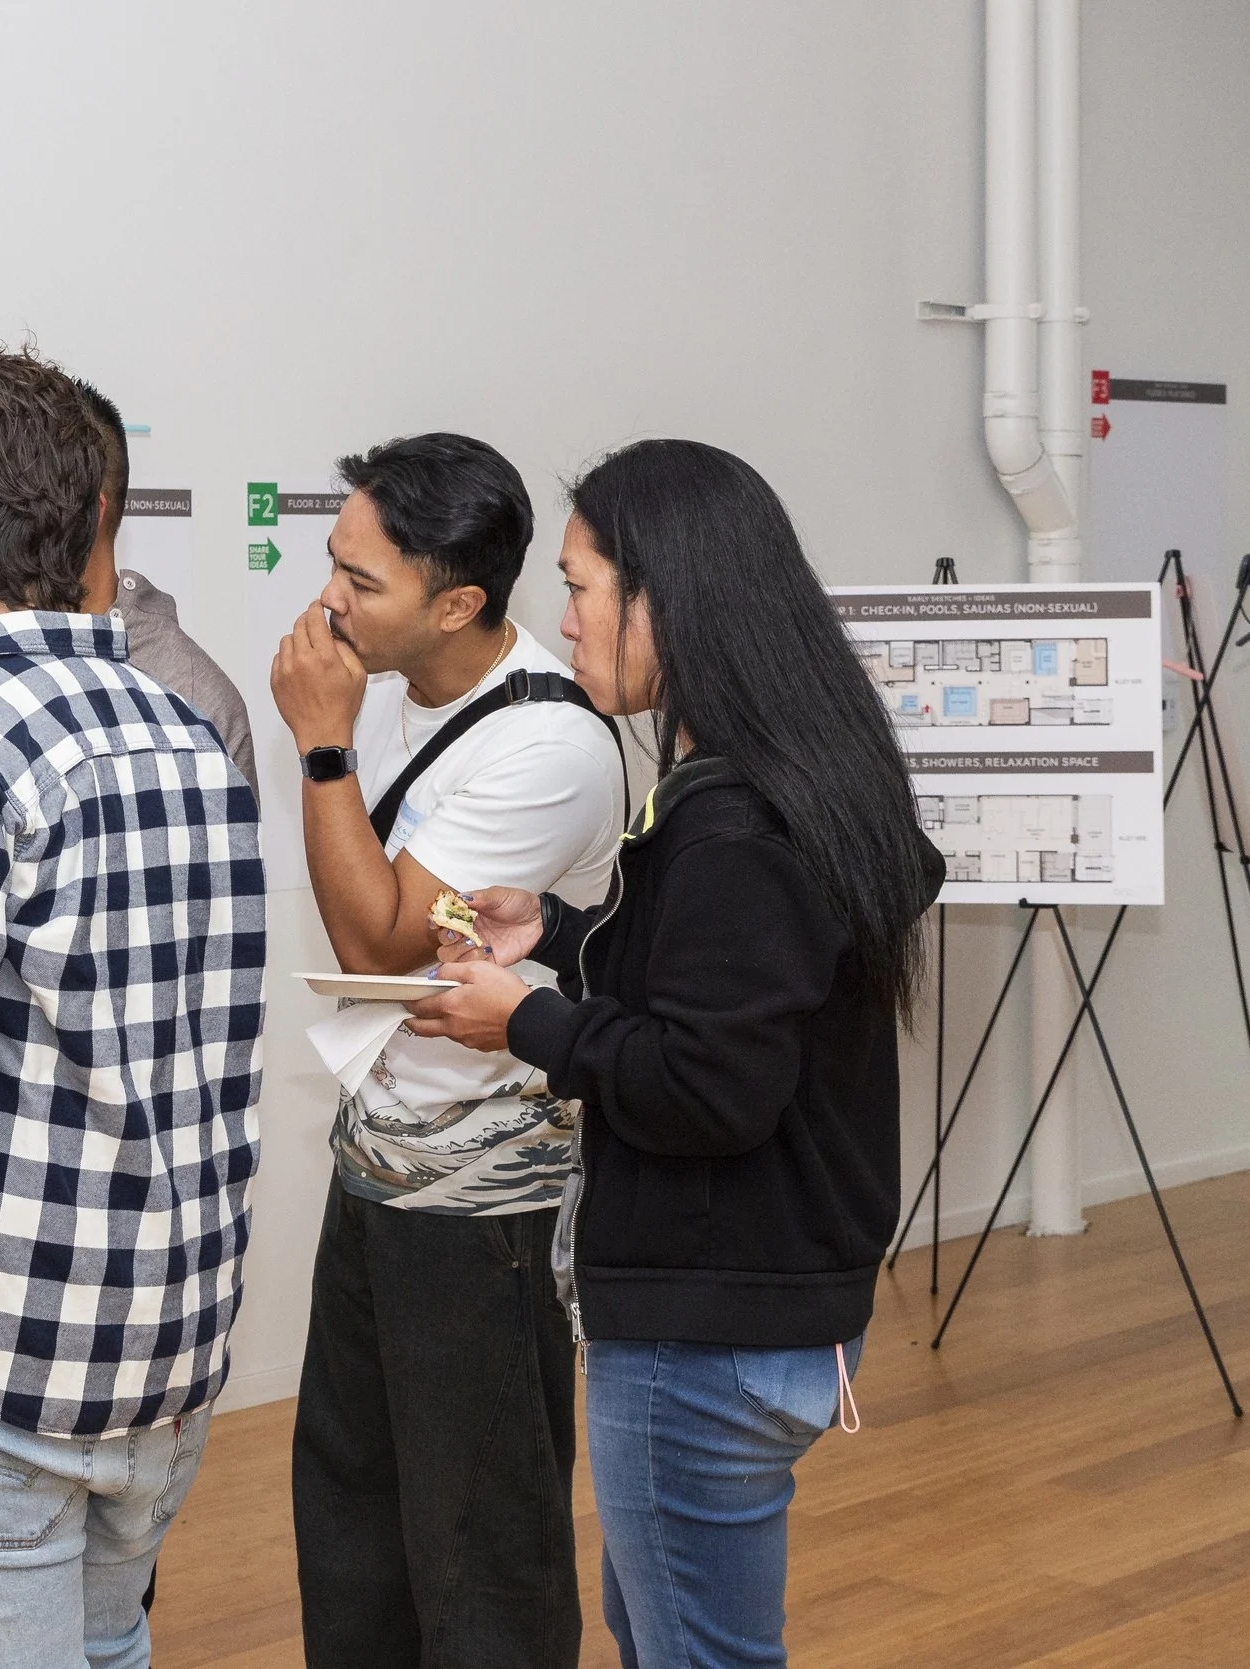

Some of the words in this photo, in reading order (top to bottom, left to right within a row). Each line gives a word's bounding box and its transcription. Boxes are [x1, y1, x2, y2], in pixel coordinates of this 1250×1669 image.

[130, 500, 190, 511] (NON-SEXUAL)
[249, 493, 275, 518] F2
[287, 499, 314, 509] FLOOR
[861, 605, 918, 617] CHECK-IN,
[920, 604, 961, 616] POOLS,
[963, 603, 1011, 615] SAUNAS
[1014, 602, 1098, 614] (NON-SEXUAL)
[922, 757, 983, 769] SHOWERS,
[985, 757, 1059, 768] RELAXATION
[1062, 756, 1100, 767] SPACE
